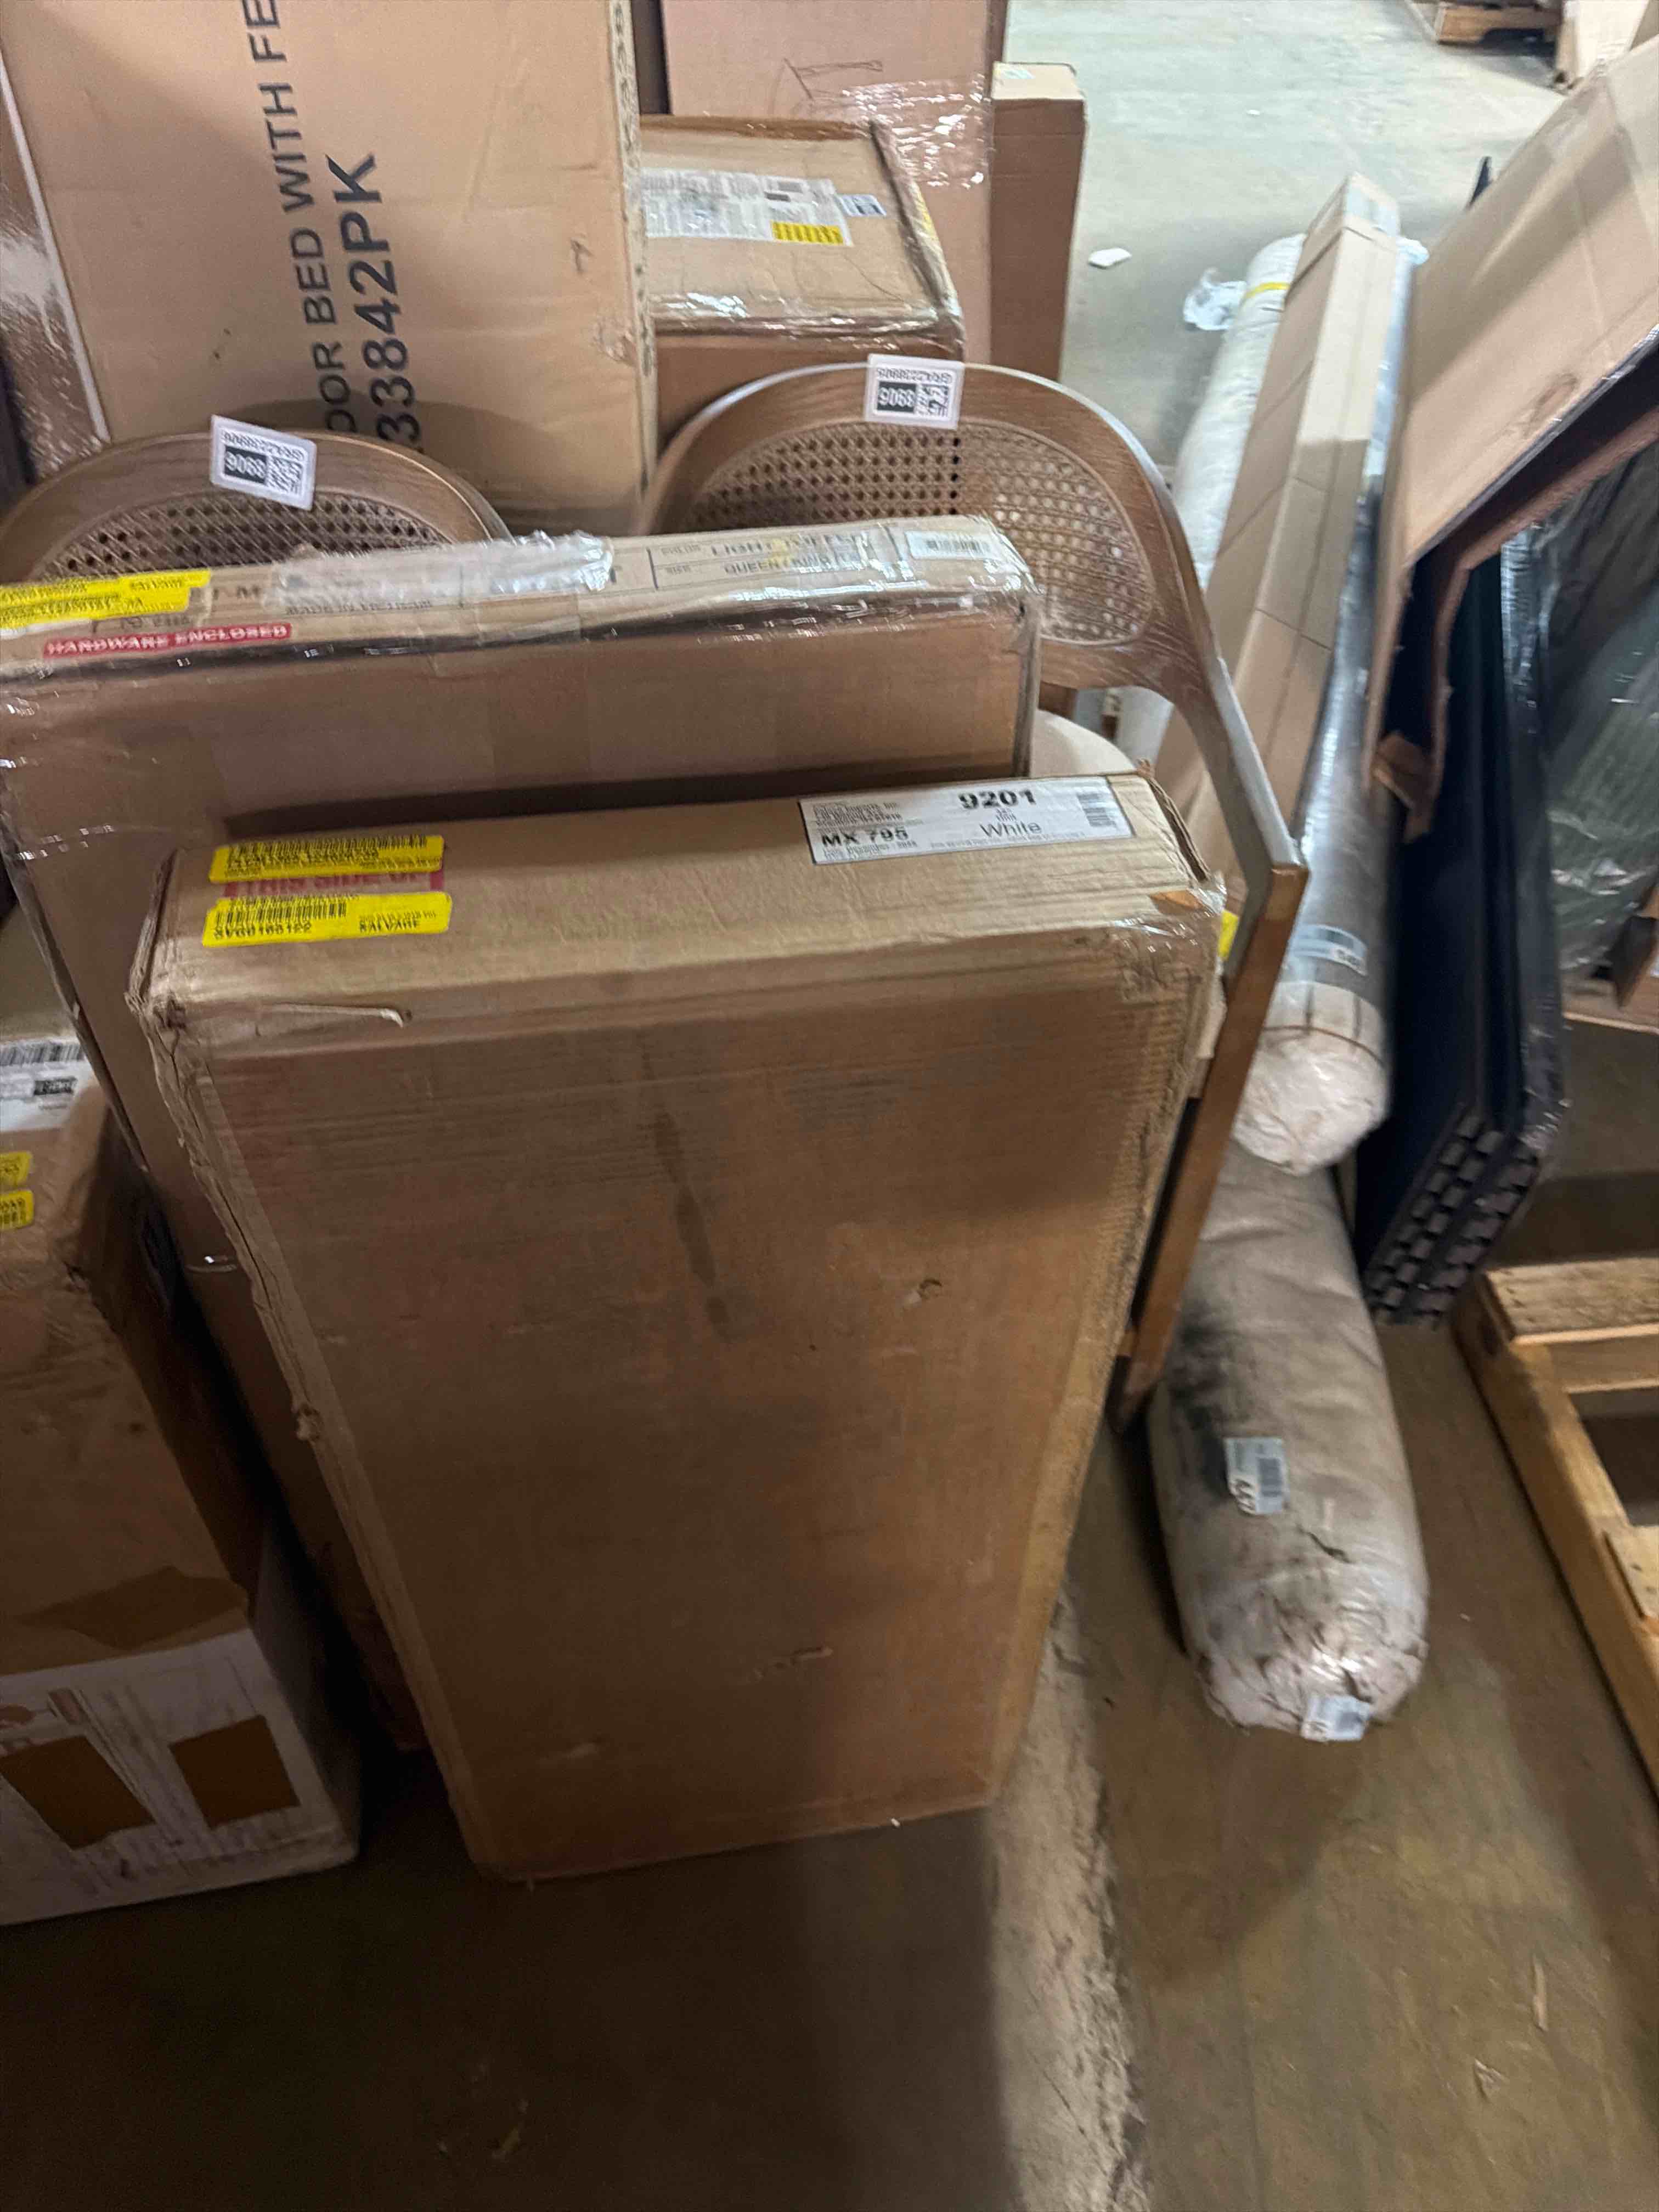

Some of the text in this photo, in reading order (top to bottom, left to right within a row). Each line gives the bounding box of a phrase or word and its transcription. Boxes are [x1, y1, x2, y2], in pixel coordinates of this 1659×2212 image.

[242, 0, 287, 62] FE
[258, 83, 314, 213] WITH
[291, 228, 337, 324] BED
[325, 153, 424, 453] 33842PK
[47, 626, 287, 654] HARDWARE ENCLOSED
[959, 789, 1036, 809] 9201
[822, 832, 859, 847] MX
[869, 826, 909, 843] 795
[980, 821, 1042, 838] White
